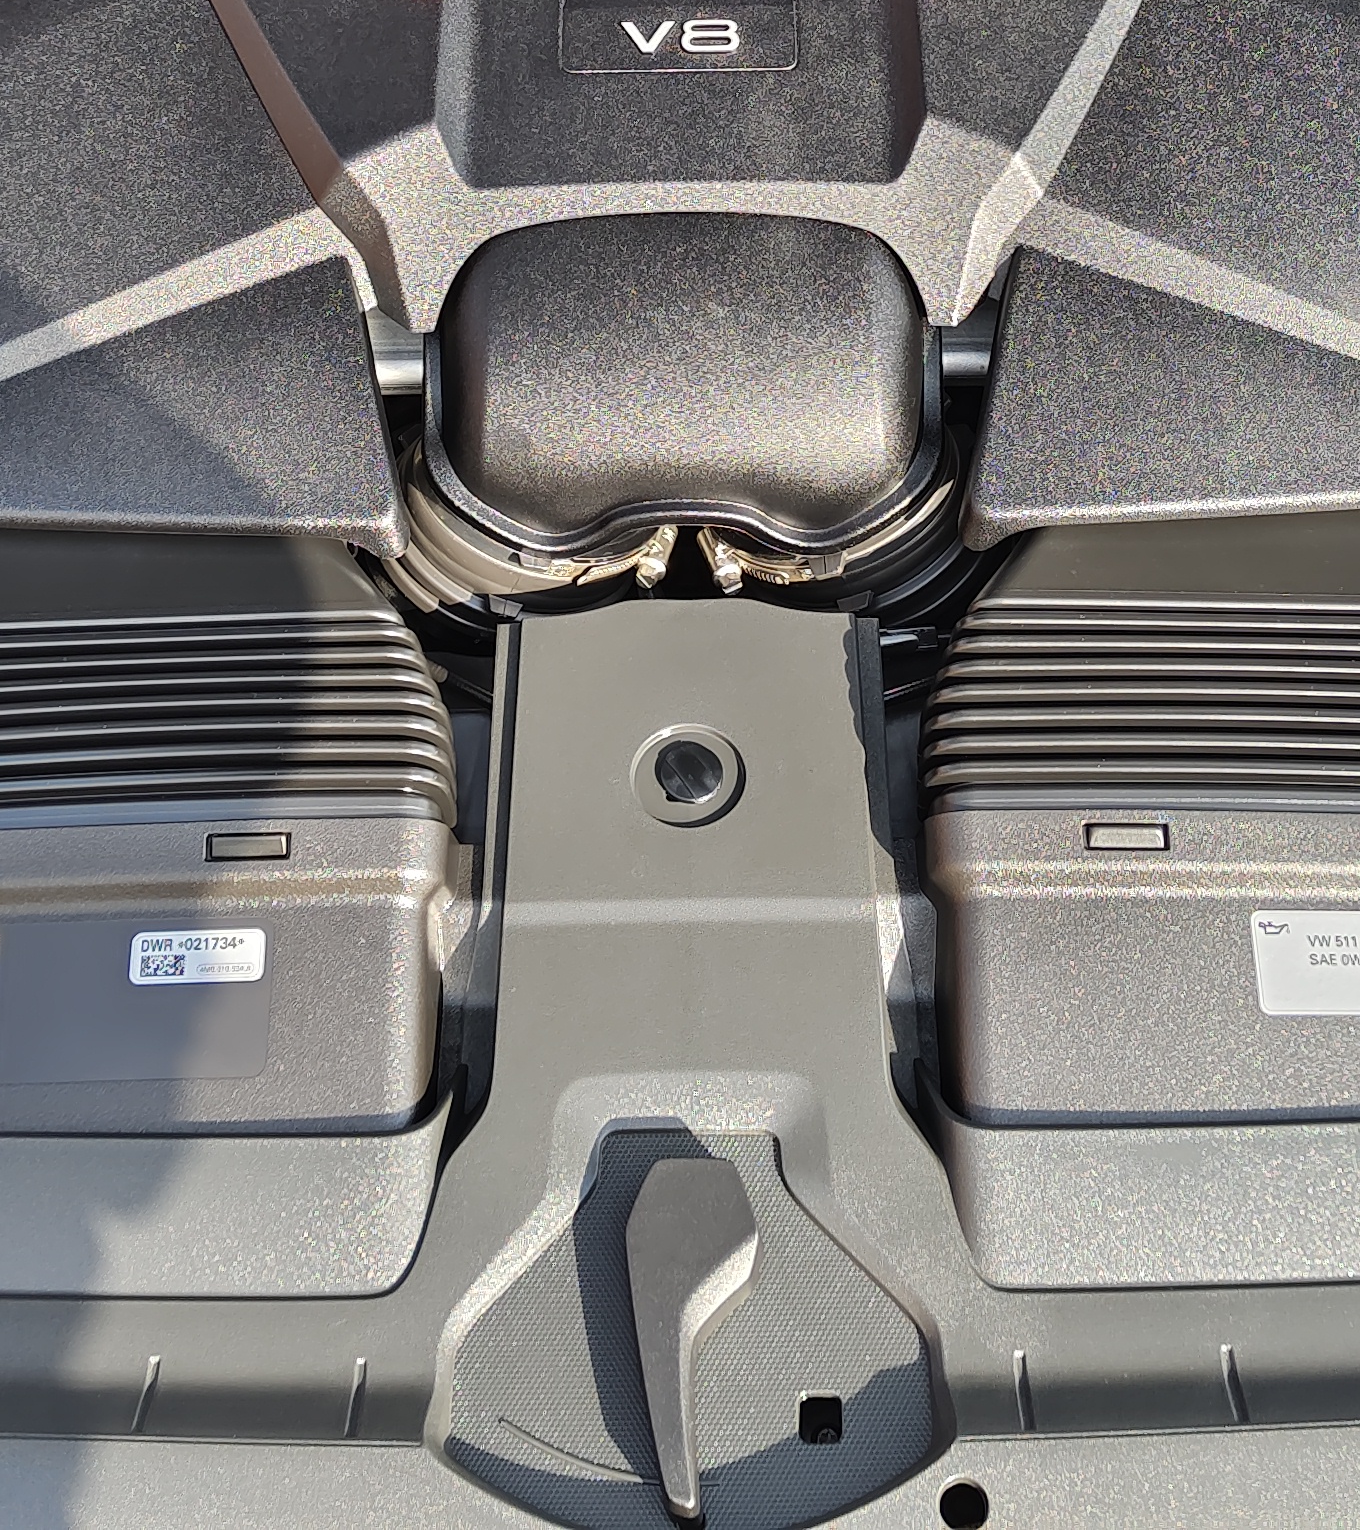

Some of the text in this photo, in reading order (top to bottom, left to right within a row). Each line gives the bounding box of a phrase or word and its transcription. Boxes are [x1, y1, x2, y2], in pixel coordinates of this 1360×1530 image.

[620, 18, 741, 55] V8
[141, 939, 173, 952] DWR
[1307, 935, 1331, 948] VW
[1336, 935, 1358, 948] 511
[1309, 954, 1337, 966] SAE
